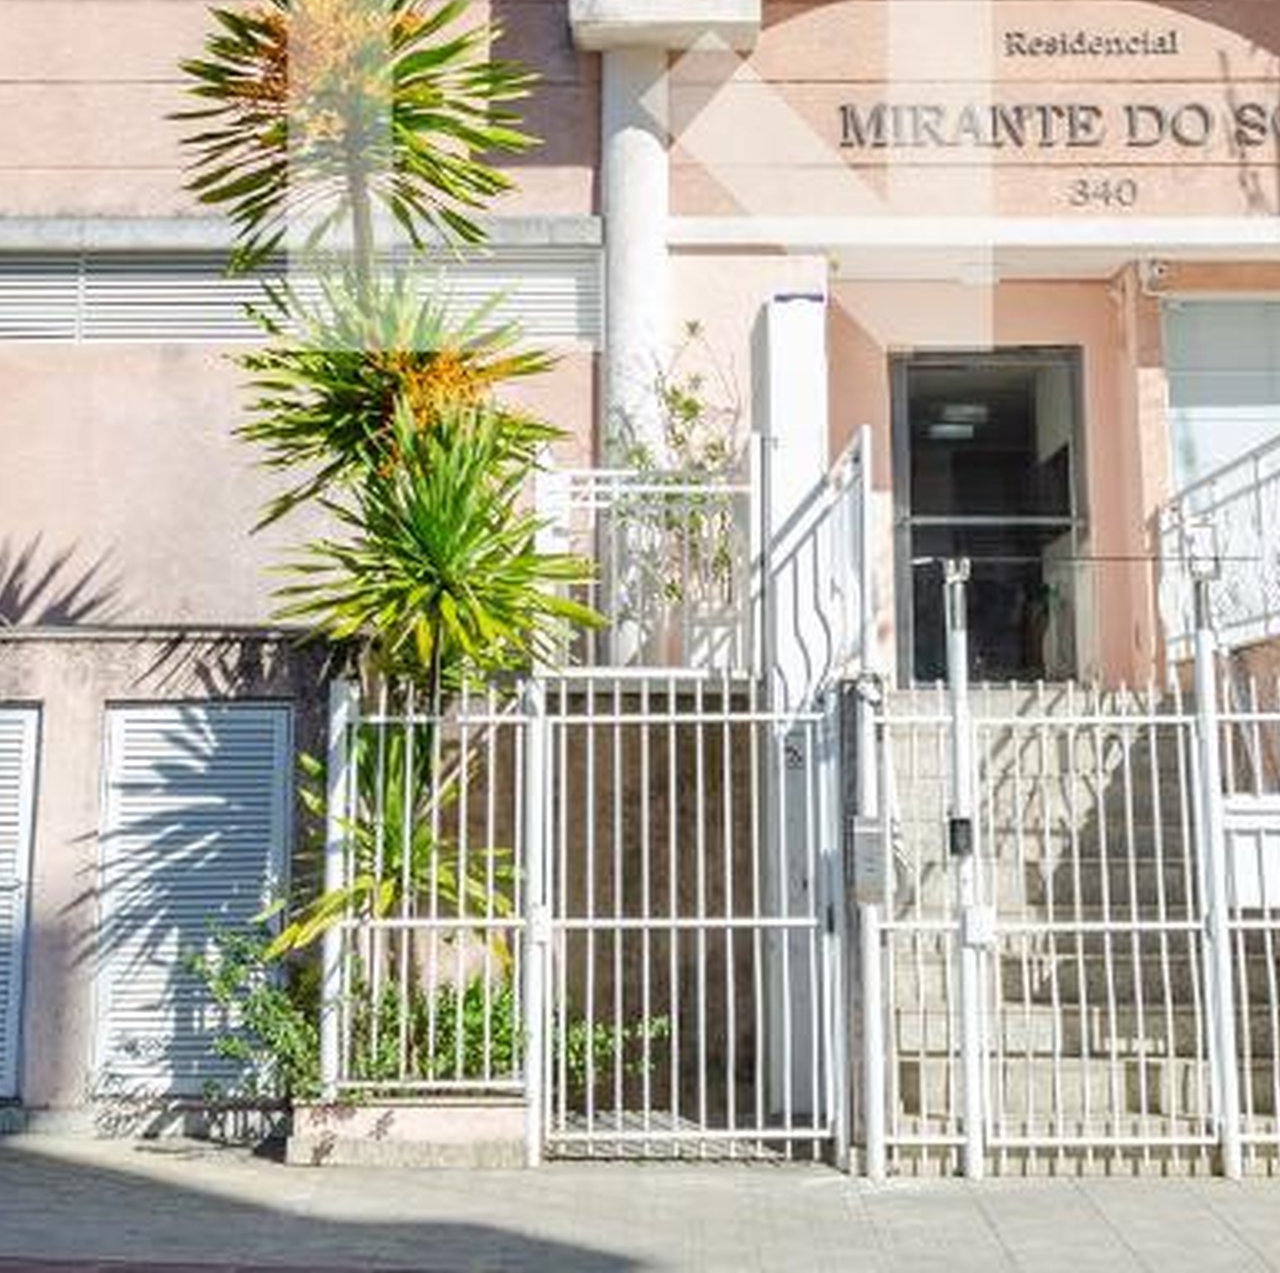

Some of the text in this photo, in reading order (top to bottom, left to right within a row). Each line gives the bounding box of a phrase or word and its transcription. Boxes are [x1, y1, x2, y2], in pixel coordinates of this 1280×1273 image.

[1005, 31, 1179, 56] Residencial
[839, 104, 1104, 148] MIRANTE
[1125, 103, 1212, 148] DO
[1068, 179, 1138, 207] 340
